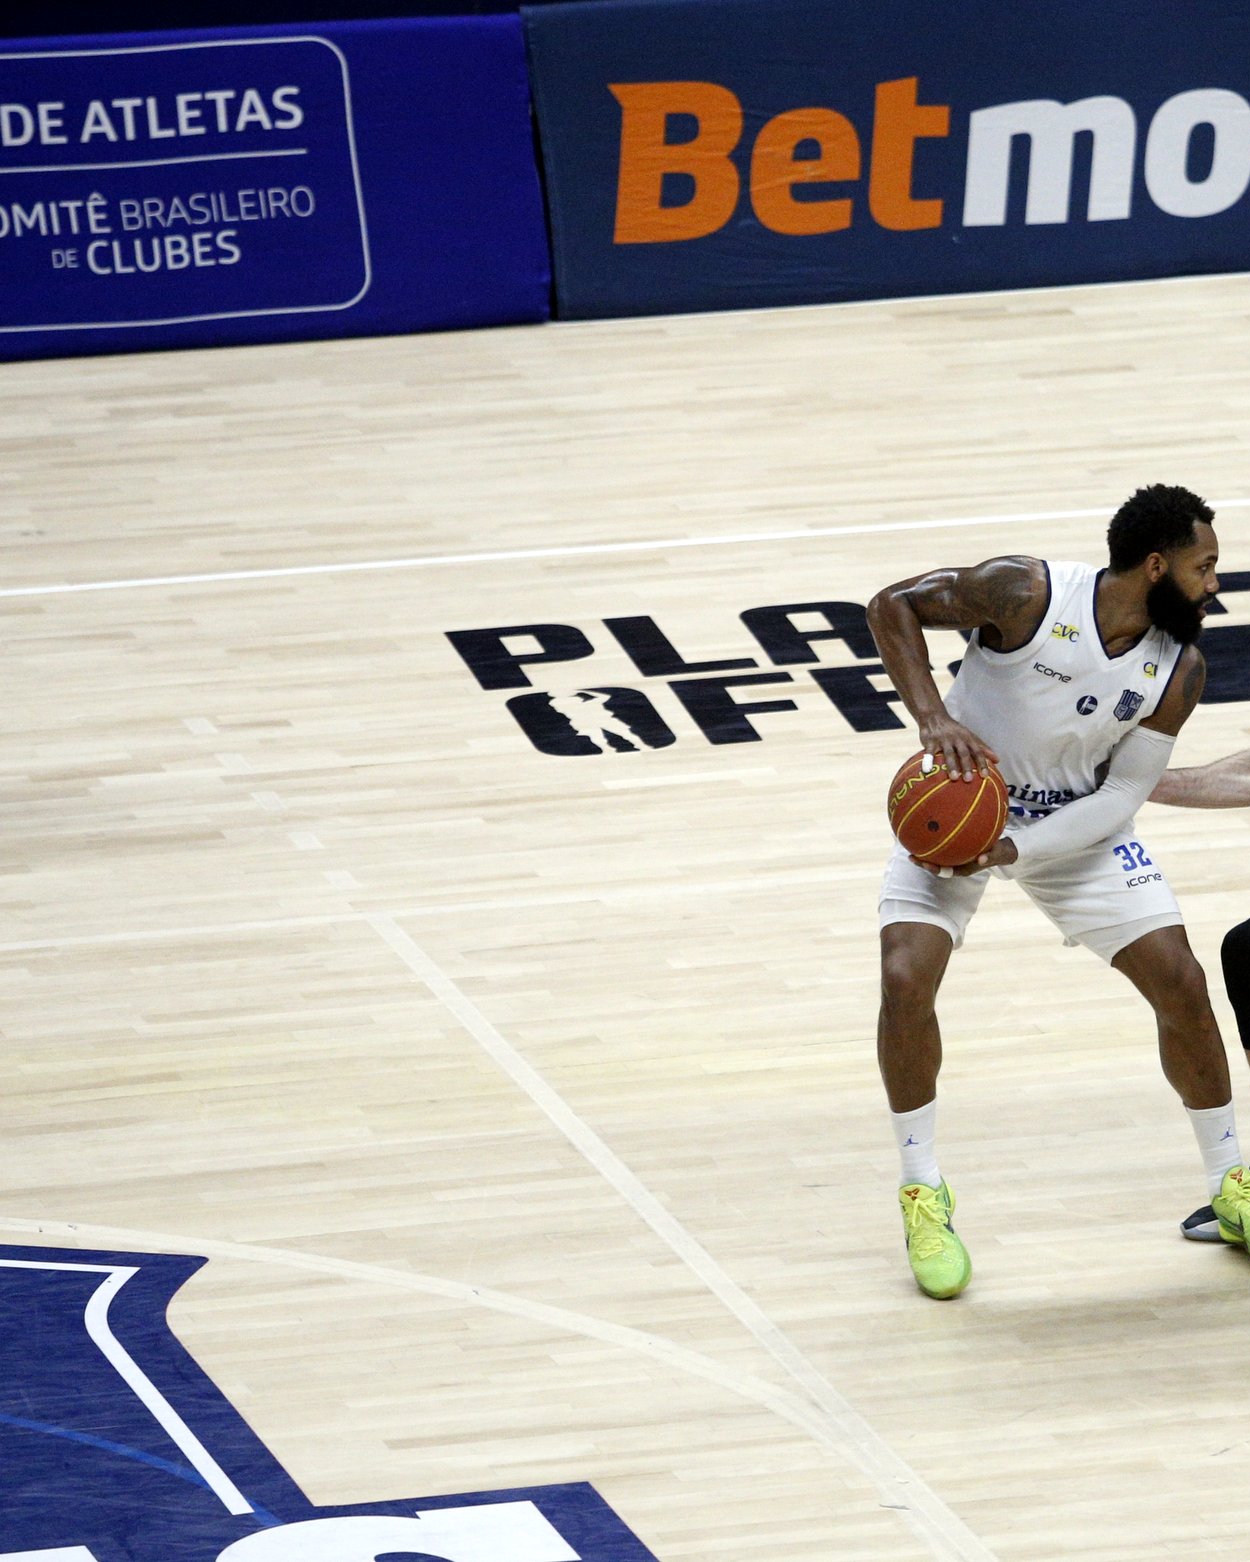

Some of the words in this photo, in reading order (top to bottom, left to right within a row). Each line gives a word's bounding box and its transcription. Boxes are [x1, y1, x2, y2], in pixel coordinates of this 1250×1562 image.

[2, 100, 68, 147] DE
[80, 86, 305, 144] ATLETAS
[121, 185, 316, 233] BRASILEIRO
[51, 249, 78, 270] DE
[86, 229, 242, 276] CLUBES
[1052, 622, 1080, 644] CVC
[1113, 842, 1153, 872] 32
